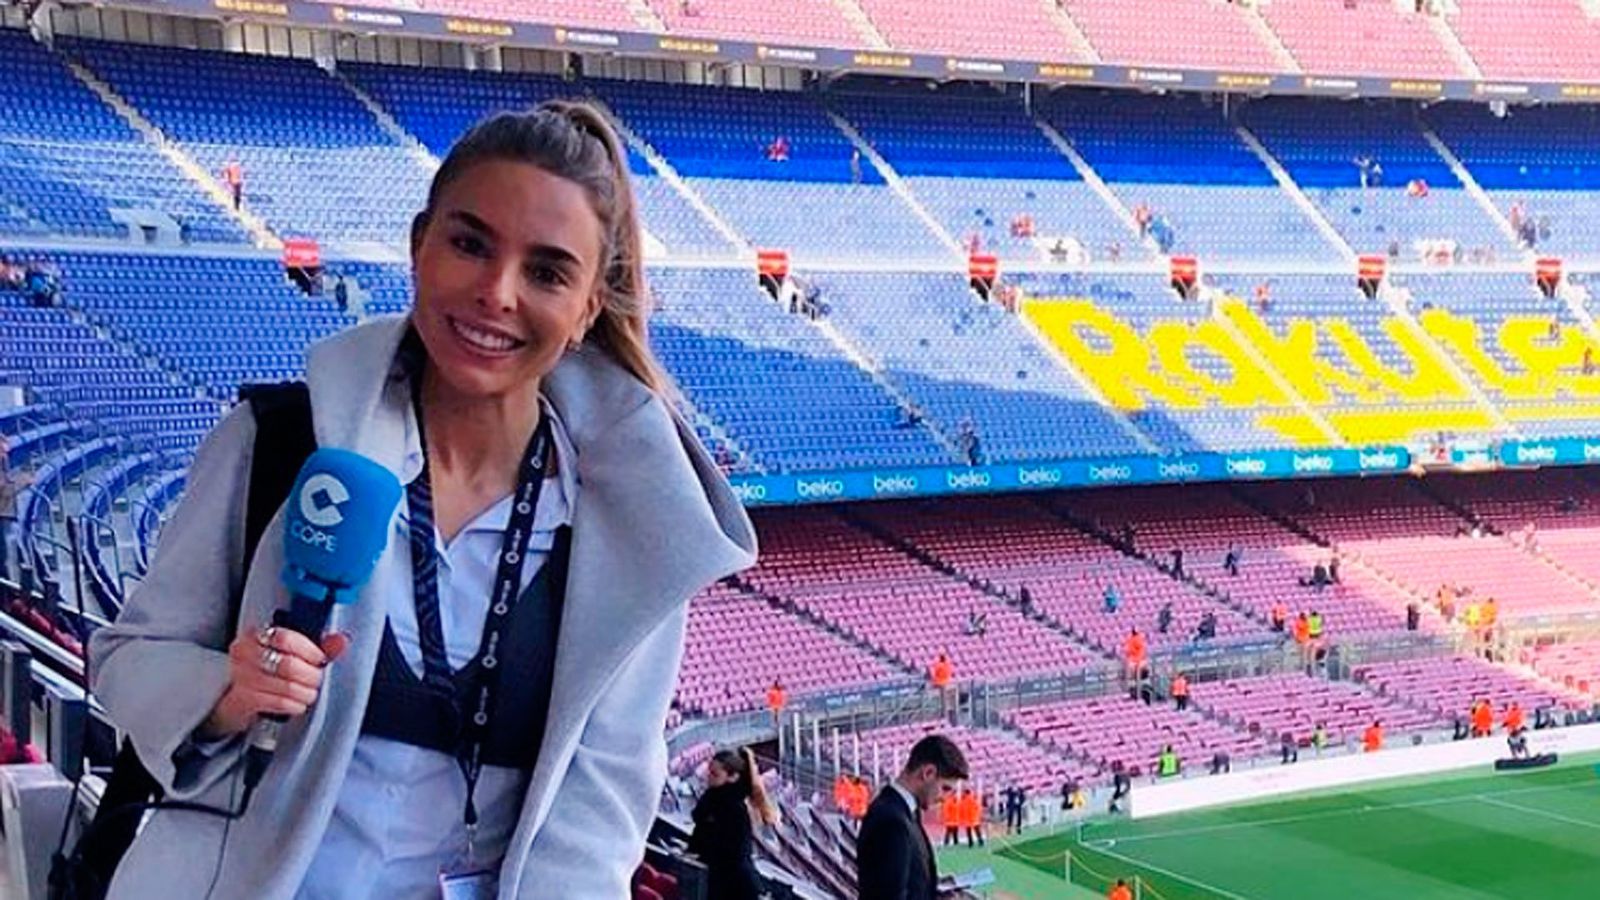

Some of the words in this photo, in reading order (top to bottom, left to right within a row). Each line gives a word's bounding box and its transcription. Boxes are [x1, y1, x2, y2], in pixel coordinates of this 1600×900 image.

[1020, 297, 1600, 412] Rakute
[731, 480, 765, 499] eko
[797, 478, 843, 497] beko
[873, 474, 918, 492] beko
[947, 470, 990, 488] beko
[1018, 466, 1061, 484] beko
[1090, 463, 1131, 480] beko
[1159, 460, 1198, 477] beko
[1226, 456, 1266, 473] beko
[1293, 452, 1333, 470] beko
[1359, 450, 1398, 468] beko
[290, 519, 337, 553] COPE
